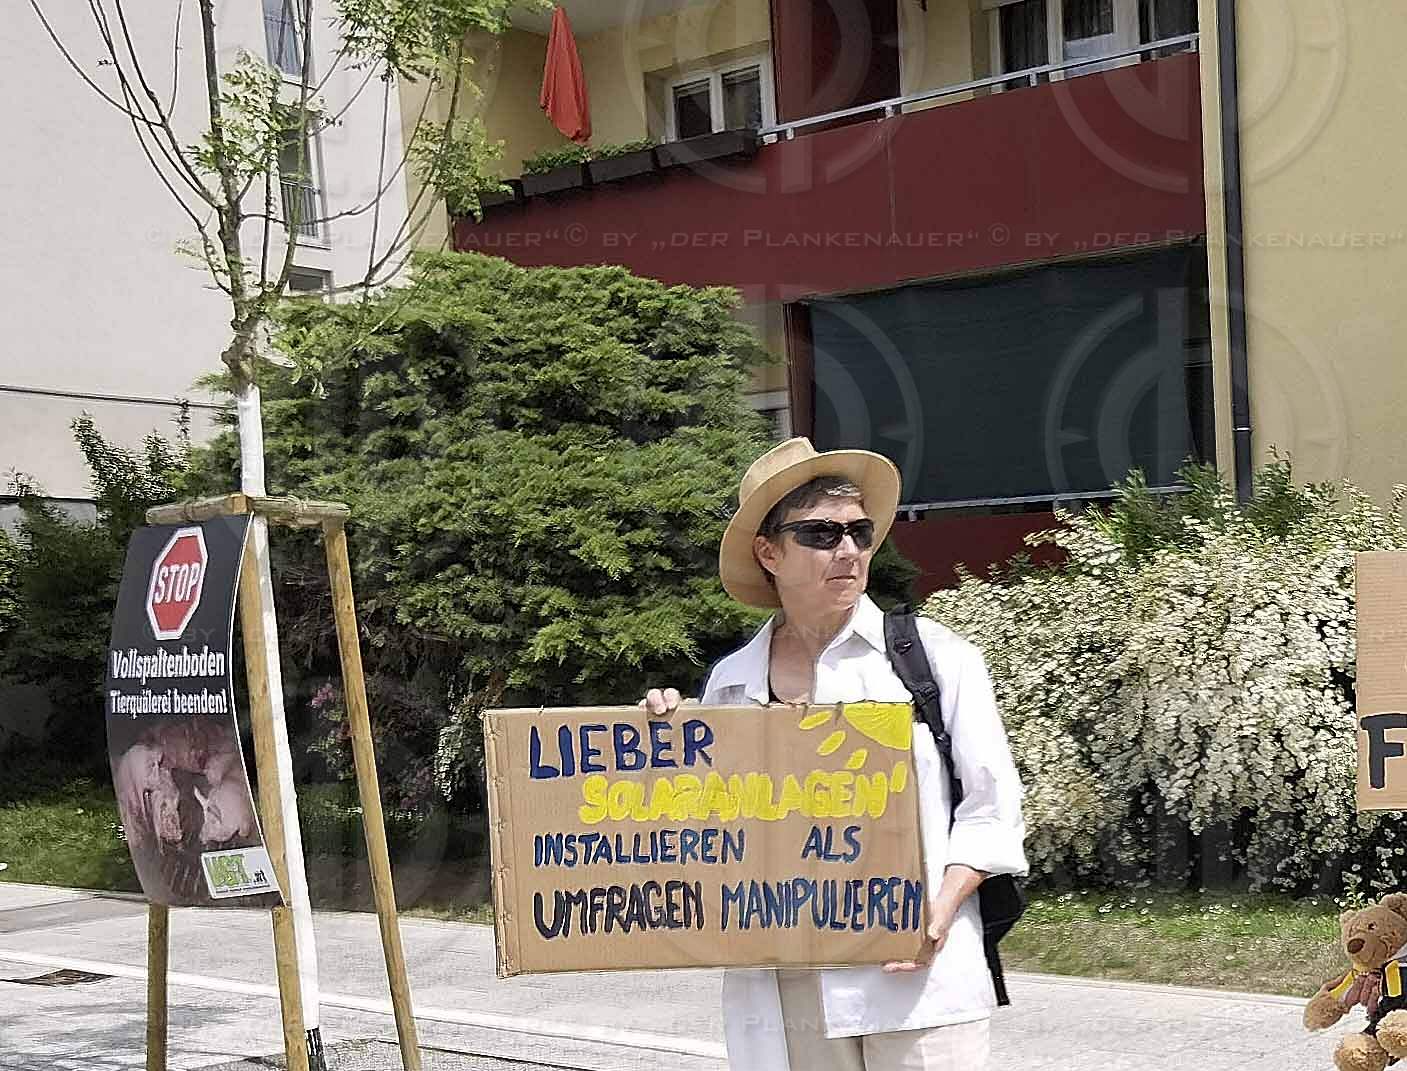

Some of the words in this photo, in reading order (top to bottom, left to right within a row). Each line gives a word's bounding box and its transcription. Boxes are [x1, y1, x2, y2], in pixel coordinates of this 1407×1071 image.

[155, 562, 201, 604] STOP
[111, 645, 226, 686] Vollspaltenboden
[110, 688, 172, 720] Tierquälerei
[173, 687, 228, 714] beenden!
[530, 719, 714, 779] LIEBER
[534, 828, 746, 867] INSTALLIEREN
[801, 825, 863, 865] ALS
[533, 880, 704, 940] UMFRAGEN
[720, 876, 924, 933] MANIPULIEREN
